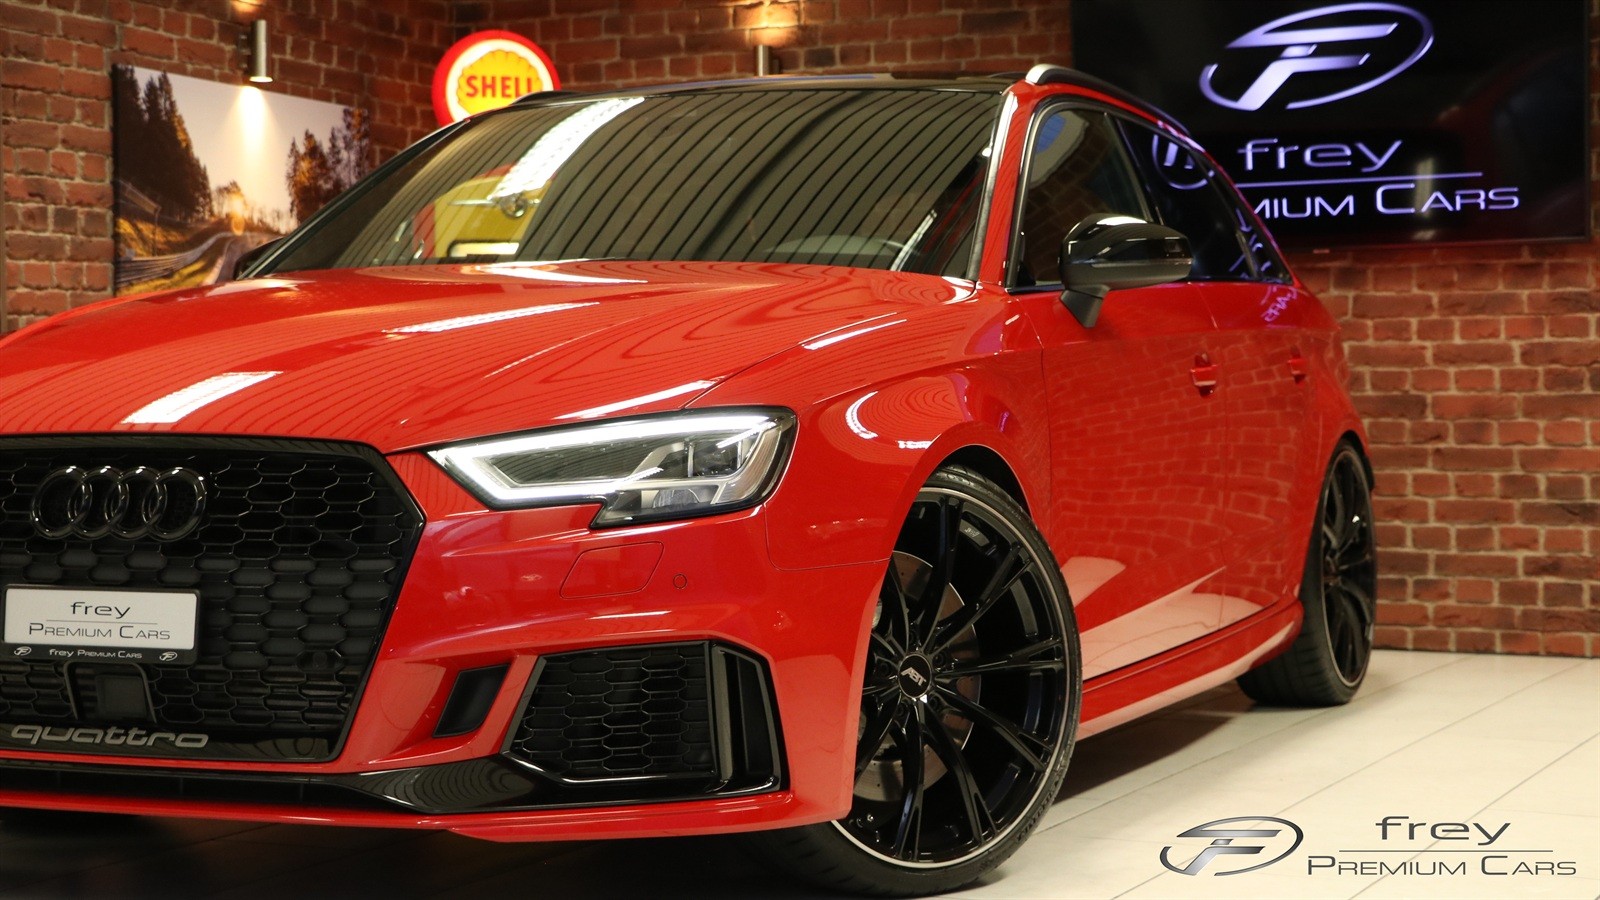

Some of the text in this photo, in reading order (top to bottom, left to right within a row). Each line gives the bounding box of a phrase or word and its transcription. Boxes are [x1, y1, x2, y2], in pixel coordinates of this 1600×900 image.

[1238, 138, 1403, 173] frey
[1375, 182, 1520, 214] CARS
[70, 601, 131, 619] frey
[29, 622, 171, 640] PREMIUM CARS
[49, 648, 143, 659] frey PREMIUM CARS
[900, 666, 927, 686] ABT
[11, 724, 209, 748] quattro
